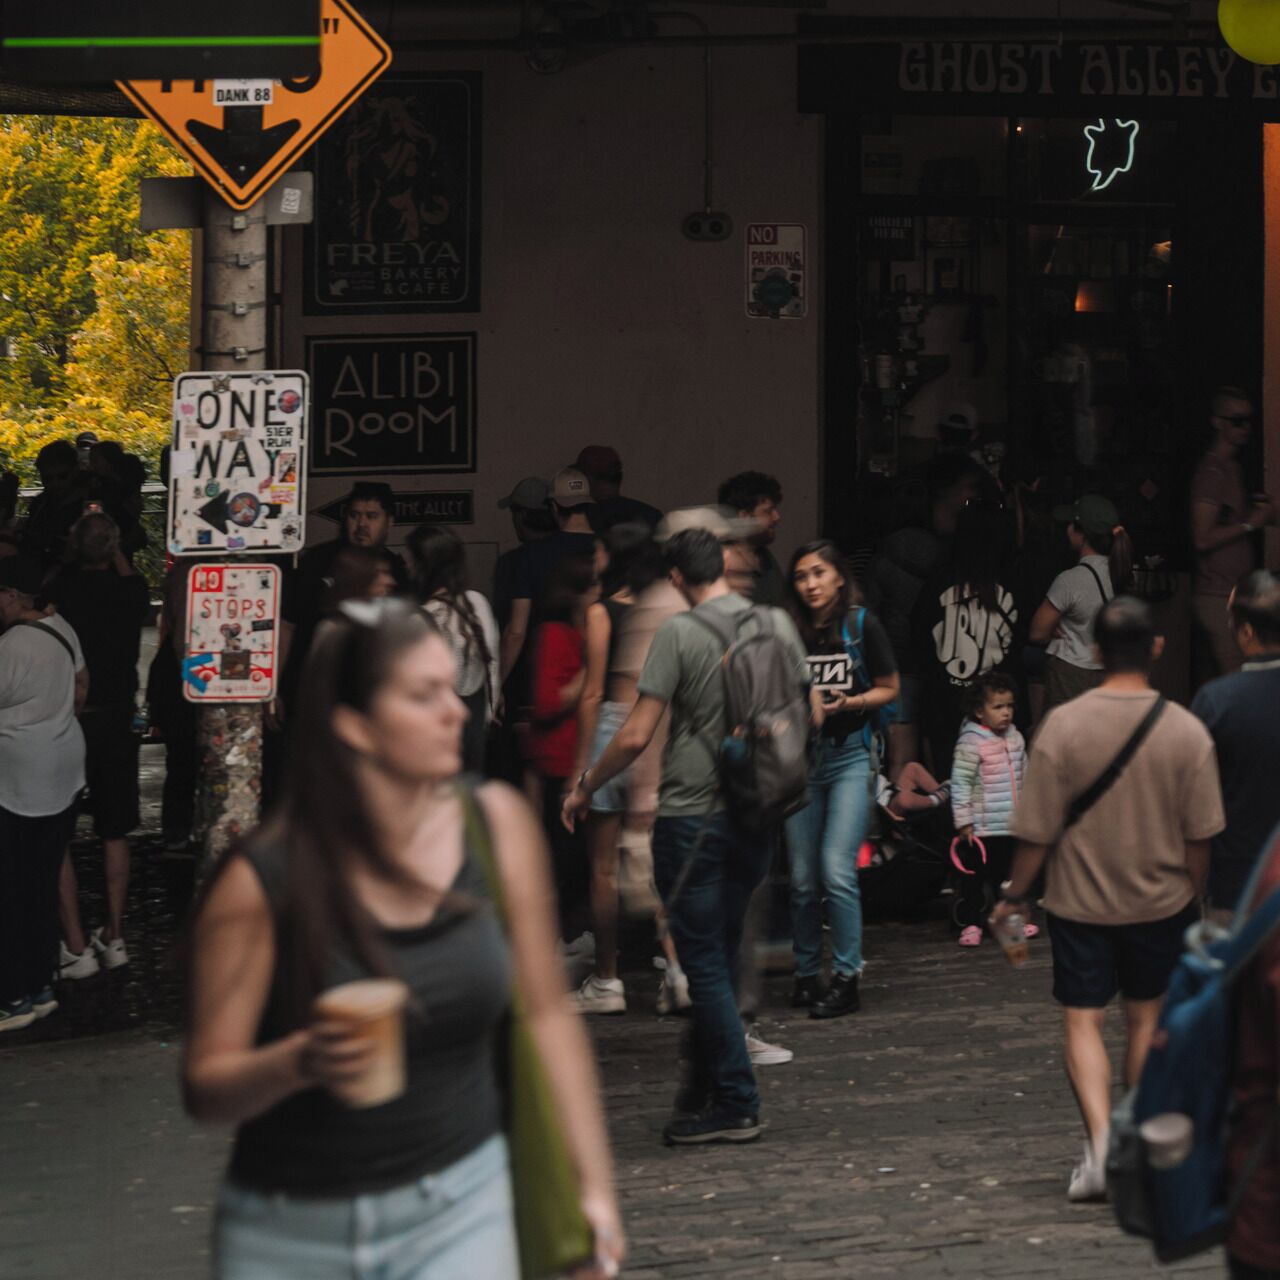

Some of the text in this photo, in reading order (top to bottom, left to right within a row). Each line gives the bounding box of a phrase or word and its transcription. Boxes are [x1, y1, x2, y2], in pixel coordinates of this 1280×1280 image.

[899, 41, 1063, 95] GHOST
[1080, 43, 1237, 98] ALLEY
[216, 87, 271, 103] DANK 88
[751, 226, 776, 244] NO
[327, 241, 460, 266] FREYA
[381, 266, 461, 282] BAKERY
[331, 350, 454, 400] ALIBI
[197, 389, 286, 429] ONE
[324, 404, 457, 457] ROOM
[191, 439, 281, 479] WAY
[200, 598, 267, 620] STOPS
